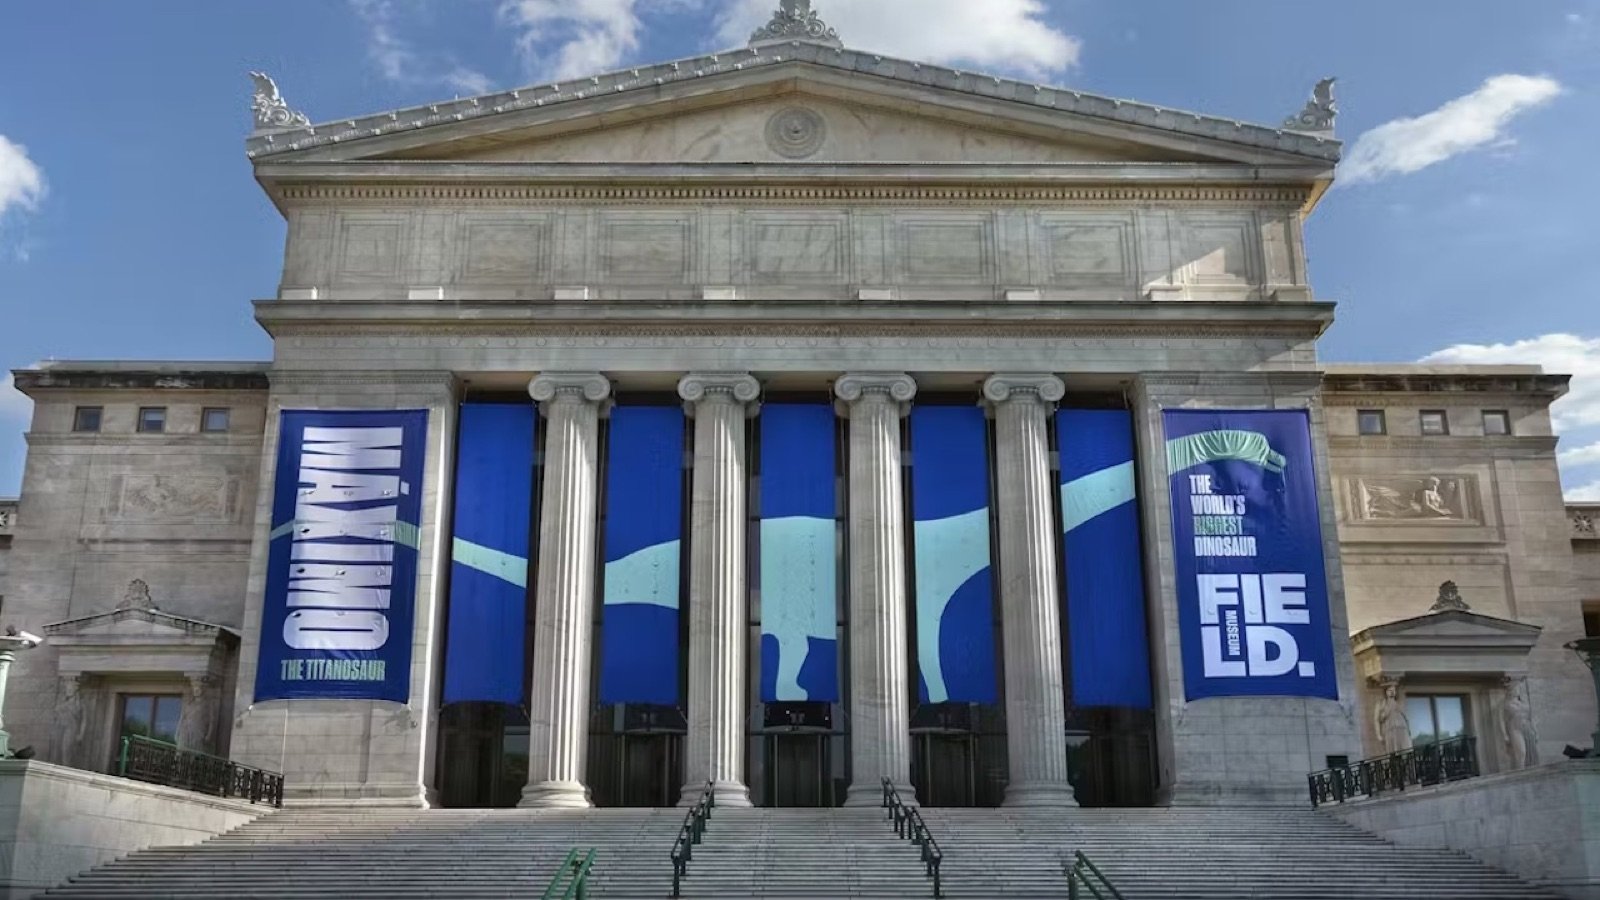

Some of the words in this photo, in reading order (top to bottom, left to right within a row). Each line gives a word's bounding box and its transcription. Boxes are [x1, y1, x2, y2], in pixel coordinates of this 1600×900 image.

[1189, 474, 1211, 494] THE
[1191, 495, 1246, 515] WORLD'S
[1194, 516, 1243, 535] BIGGEST
[283, 427, 410, 650] MÁXIMO
[1195, 536, 1256, 556] DINOSAUR
[1225, 609, 1240, 656] MUSEUM
[281, 659, 303, 681] THE
[305, 659, 386, 681] TITANOSAUR
